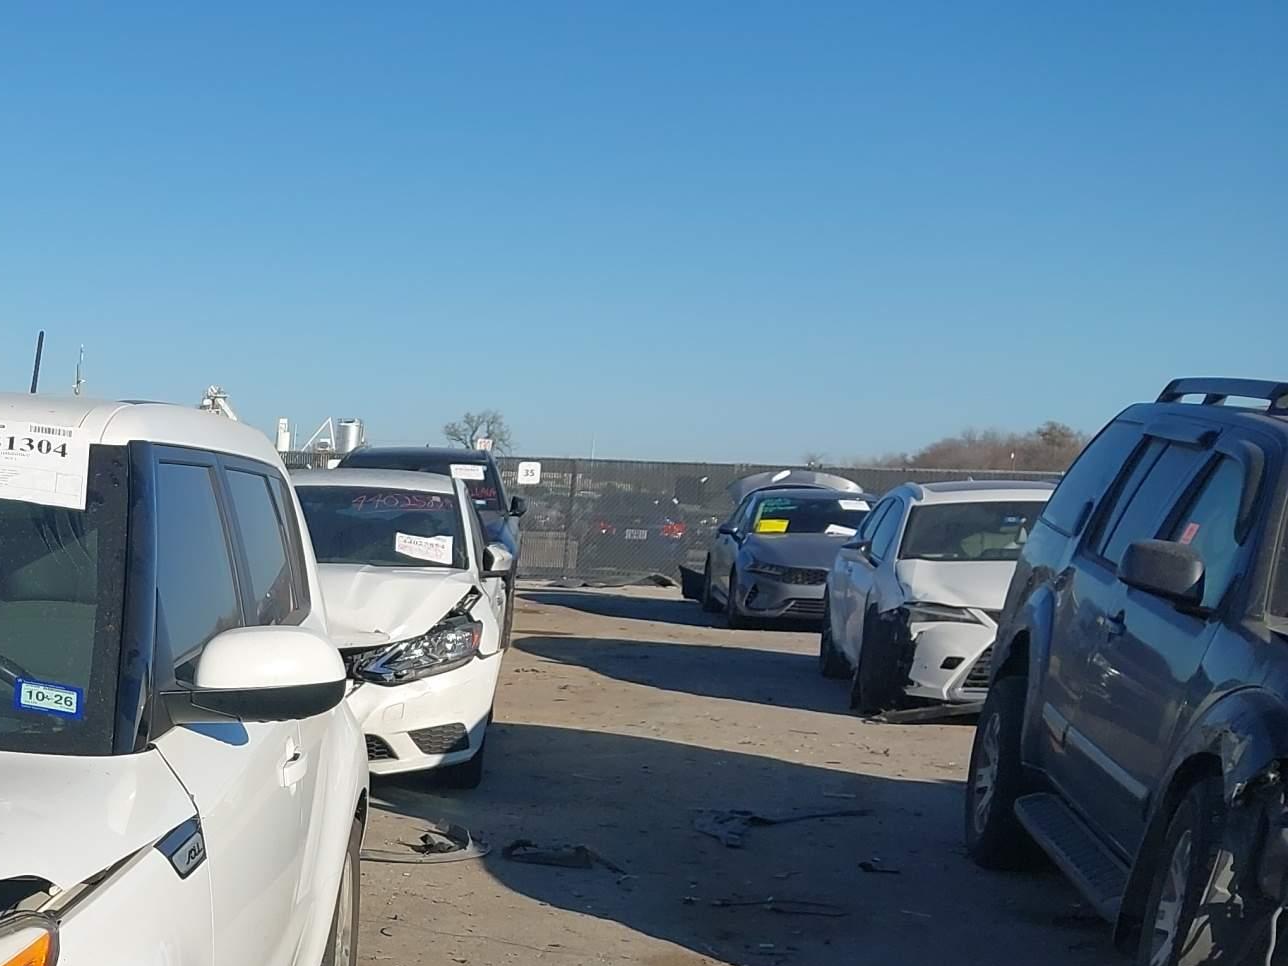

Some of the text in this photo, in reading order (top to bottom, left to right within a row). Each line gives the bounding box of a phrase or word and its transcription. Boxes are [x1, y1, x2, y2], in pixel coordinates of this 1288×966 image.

[523, 469, 535, 477] 35
[26, 690, 45, 702] 10
[53, 694, 73, 707] 26
